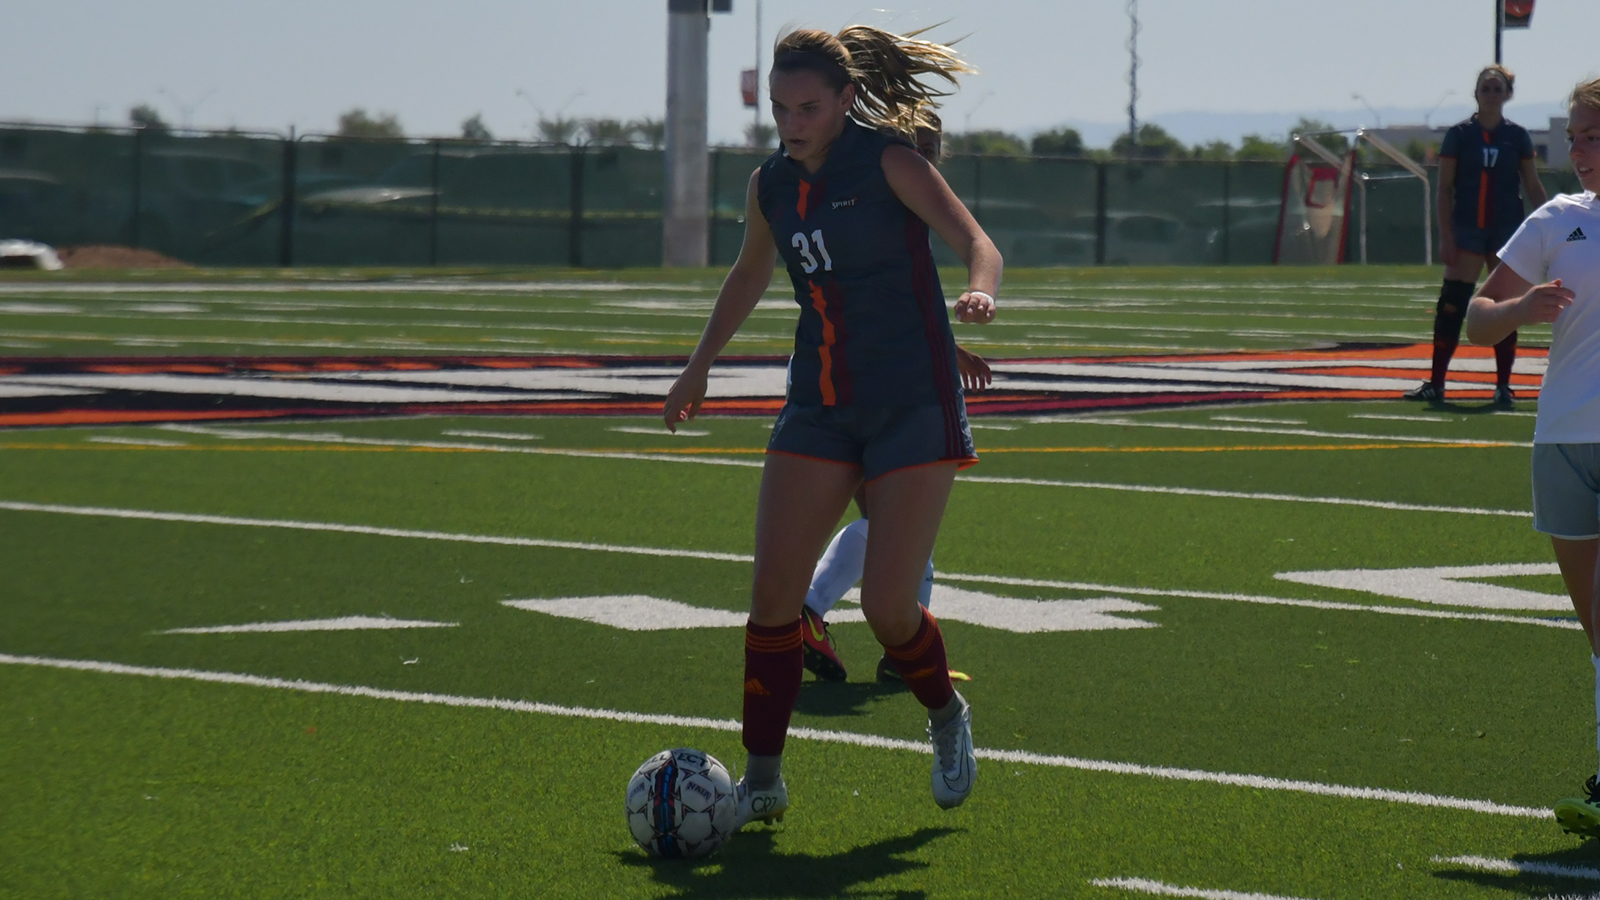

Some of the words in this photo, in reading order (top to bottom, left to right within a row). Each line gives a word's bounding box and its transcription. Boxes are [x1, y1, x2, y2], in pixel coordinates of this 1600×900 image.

[1483, 148, 1499, 168] 17
[831, 198, 855, 210] SPIRIT
[792, 229, 832, 274] 31
[751, 796, 778, 813] CR7
